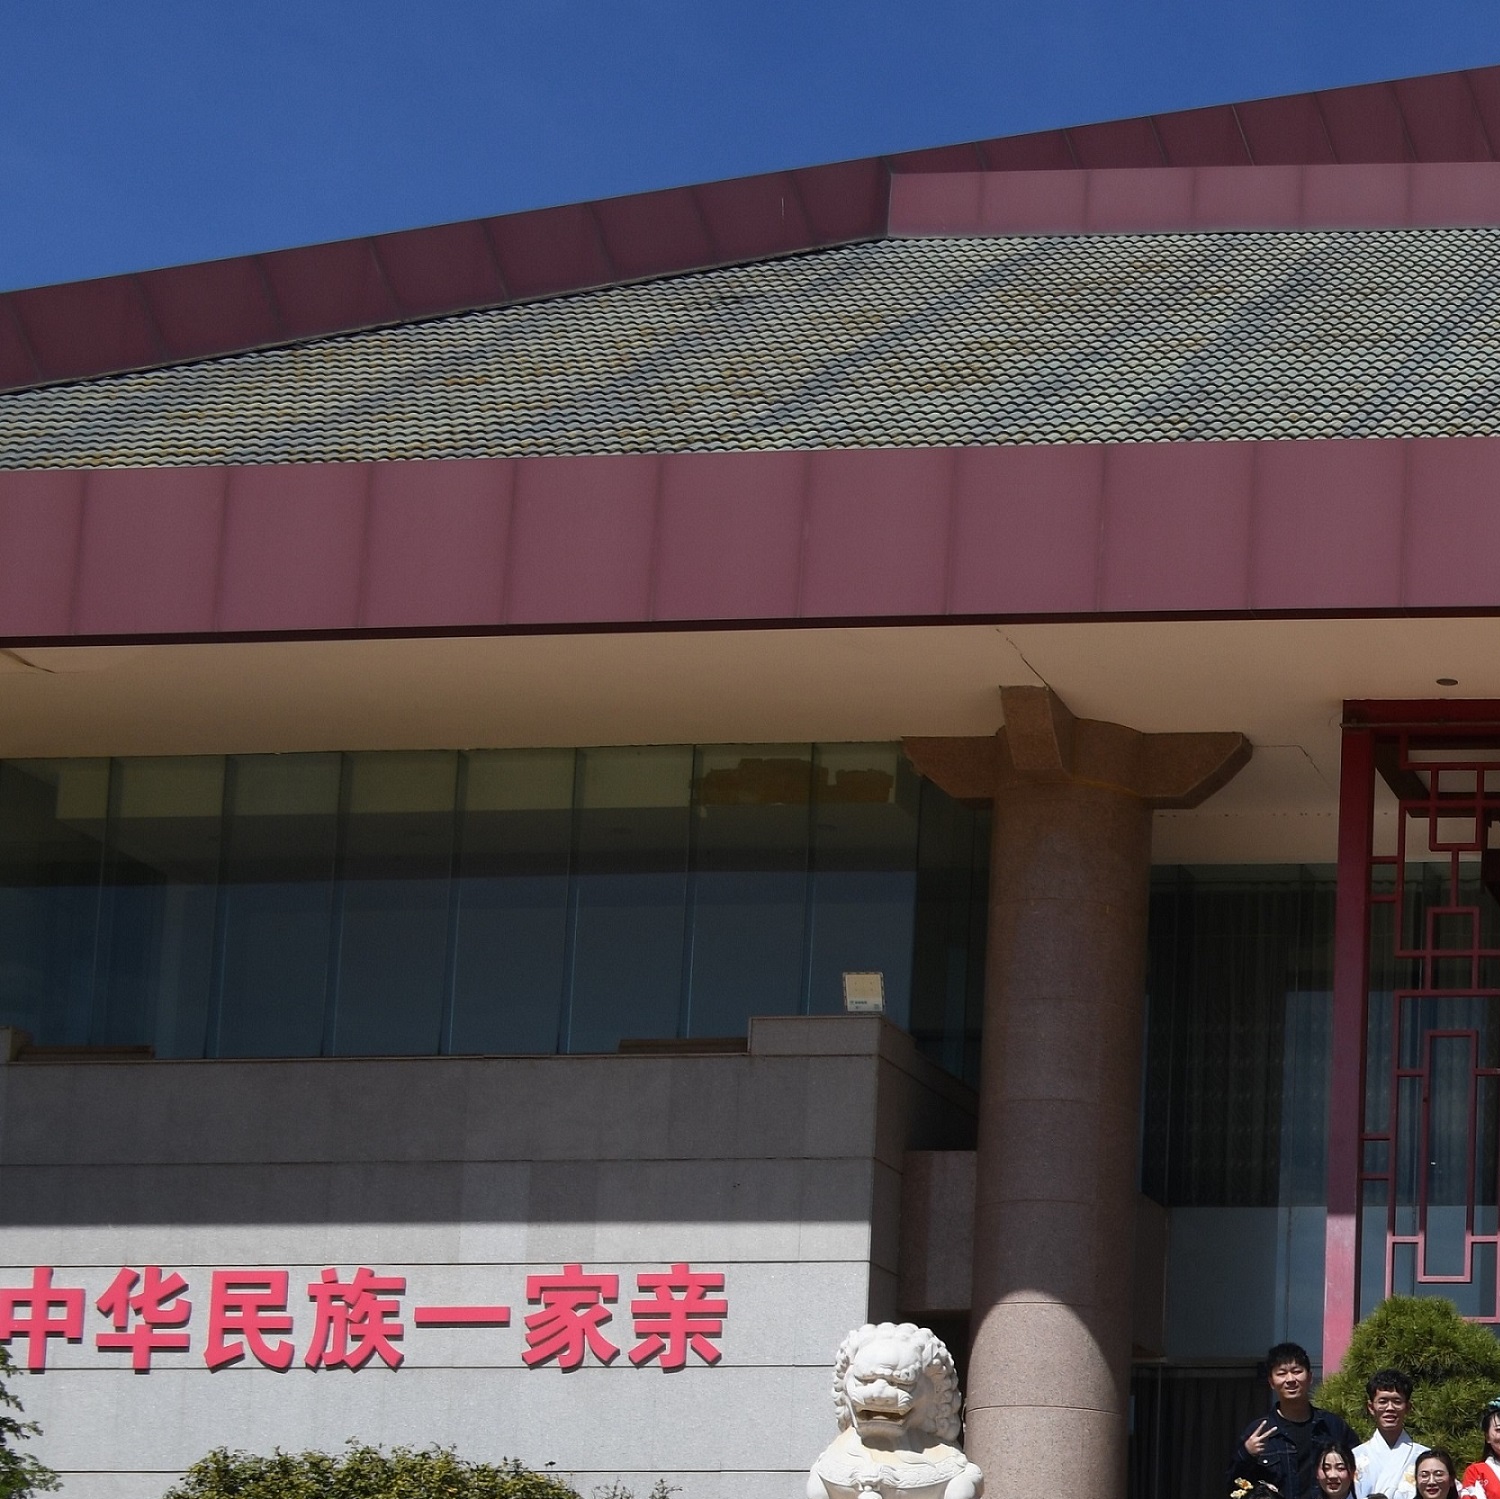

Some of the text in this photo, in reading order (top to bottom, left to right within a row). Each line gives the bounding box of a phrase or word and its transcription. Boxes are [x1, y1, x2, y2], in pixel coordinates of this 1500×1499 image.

[0, 1264, 729, 1369] 中华民族一家亲
